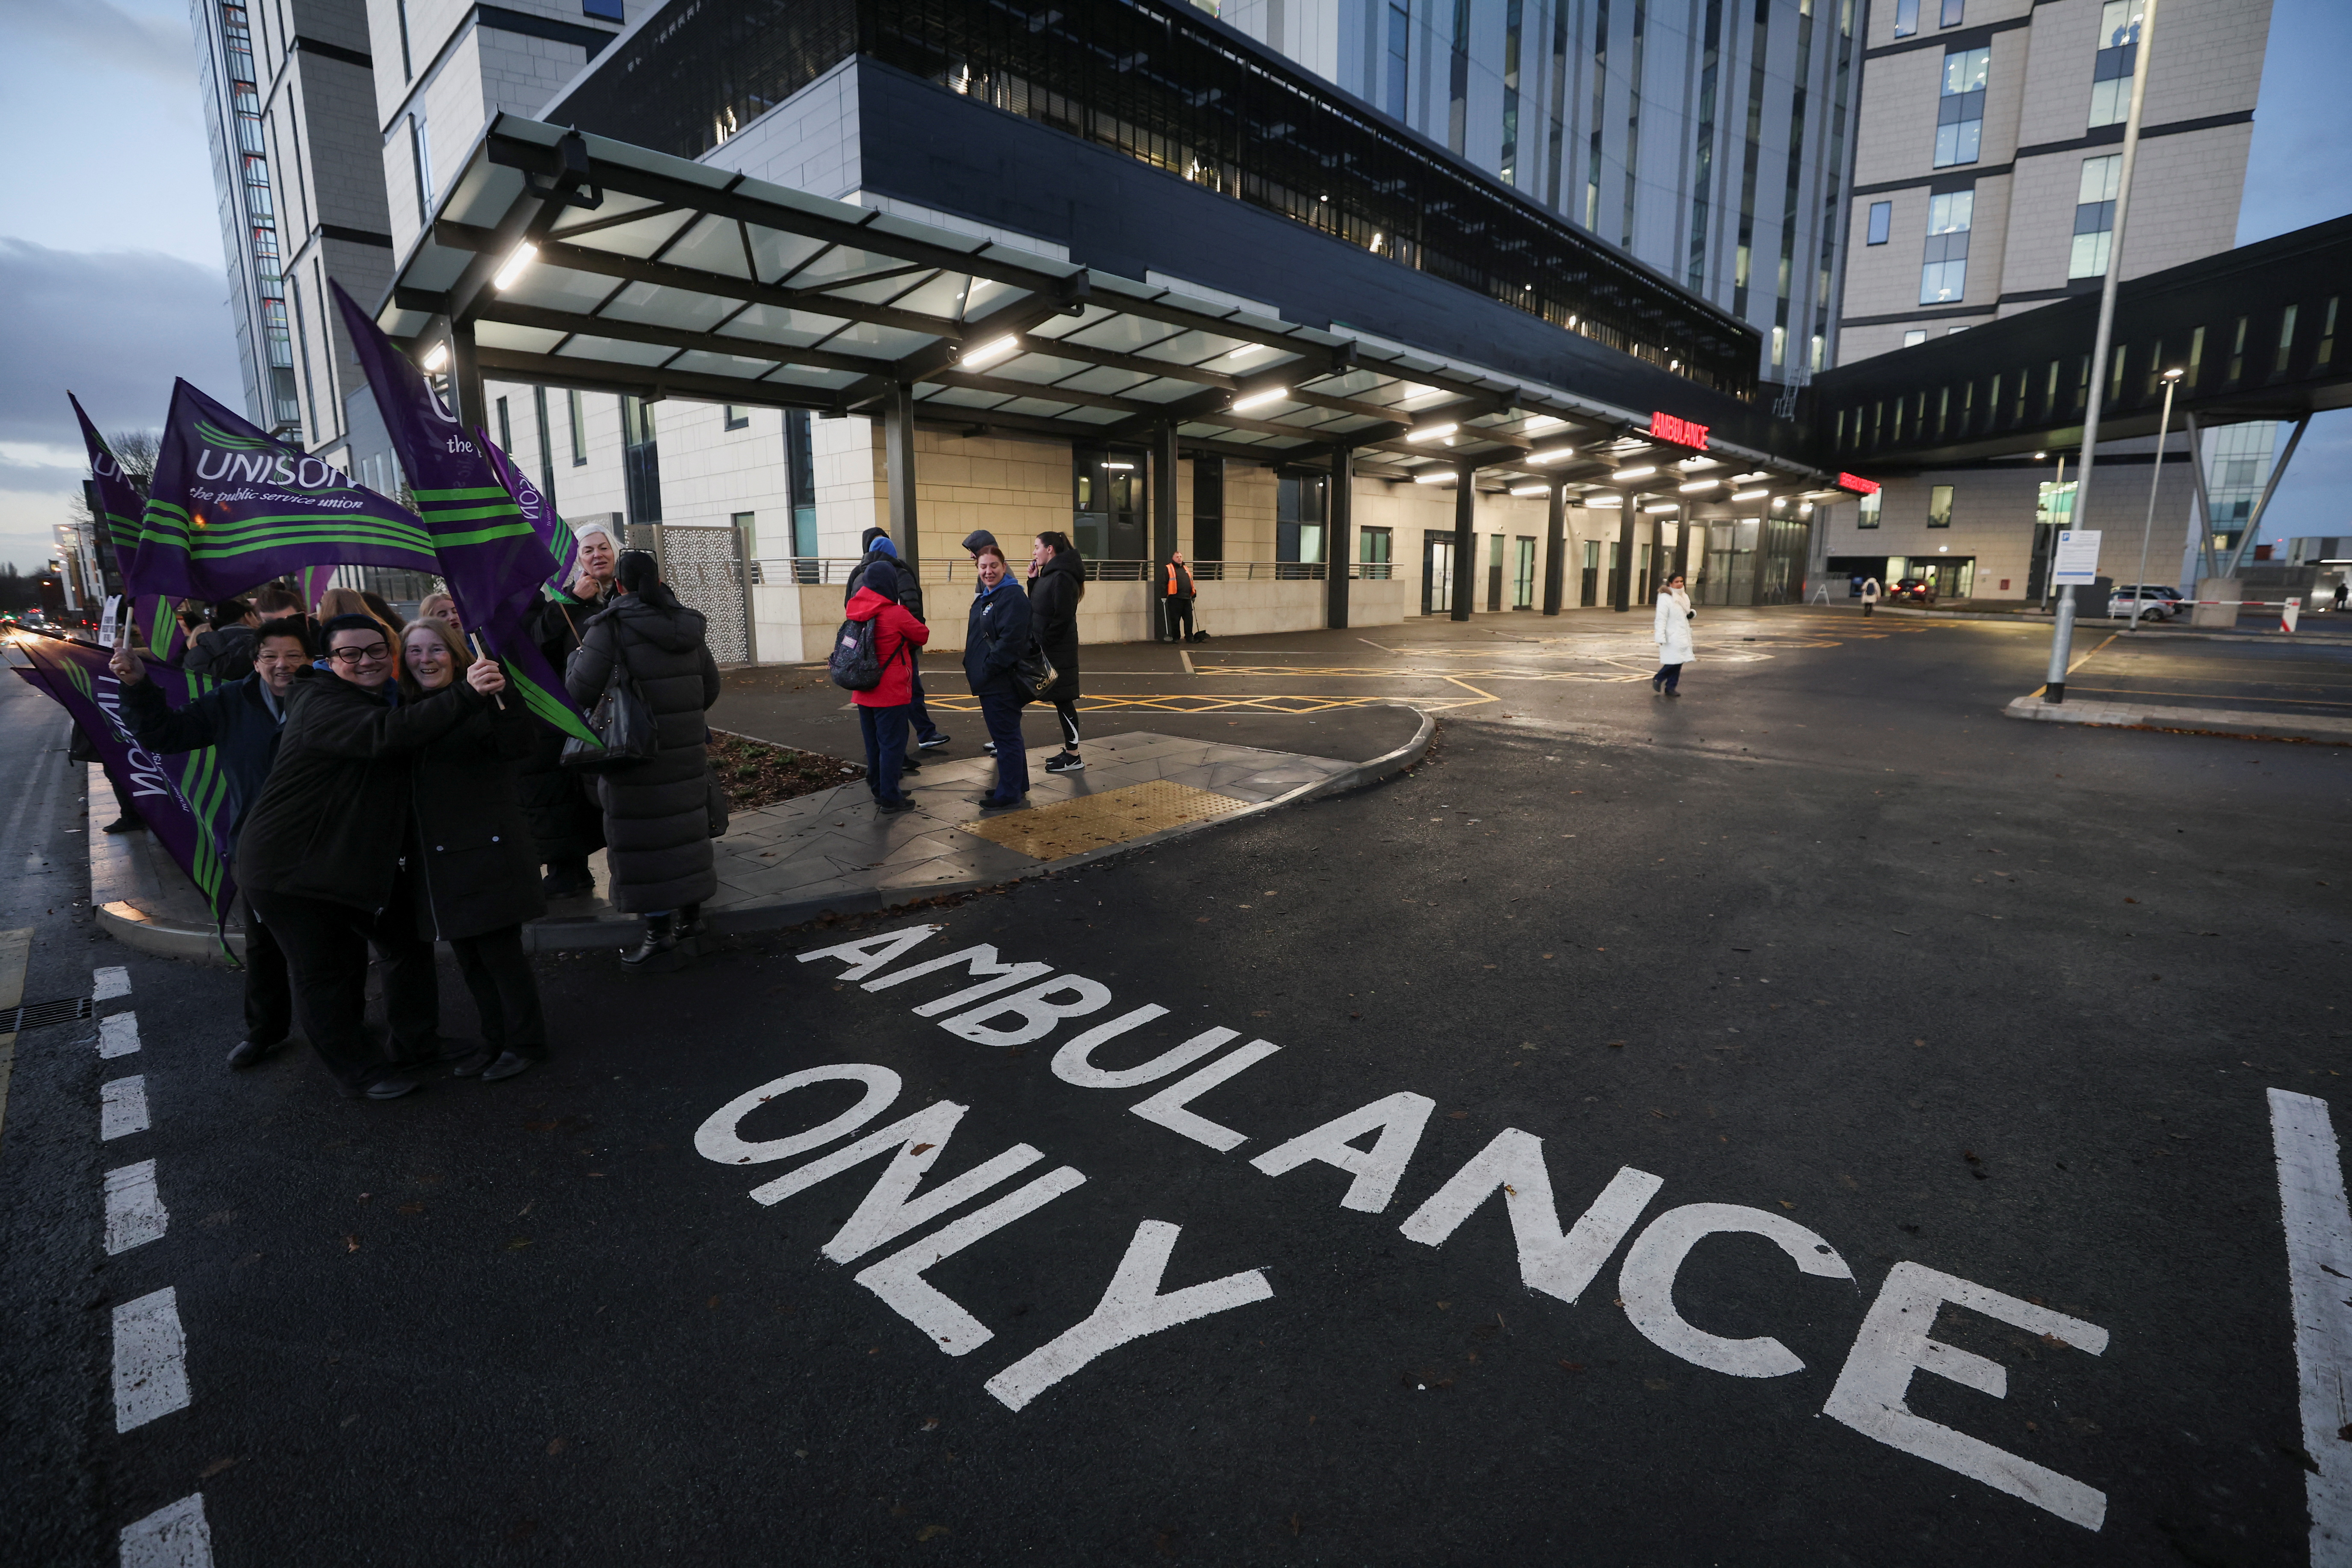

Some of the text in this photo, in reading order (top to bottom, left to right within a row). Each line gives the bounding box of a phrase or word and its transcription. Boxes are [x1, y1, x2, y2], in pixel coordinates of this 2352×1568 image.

[446, 434, 473, 454] the
[1650, 411, 1710, 450] AMBULANCE
[190, 487, 364, 508] the public service union
[694, 1063, 1274, 1412] ONLY
[795, 924, 2109, 1532] AMBULANCE
